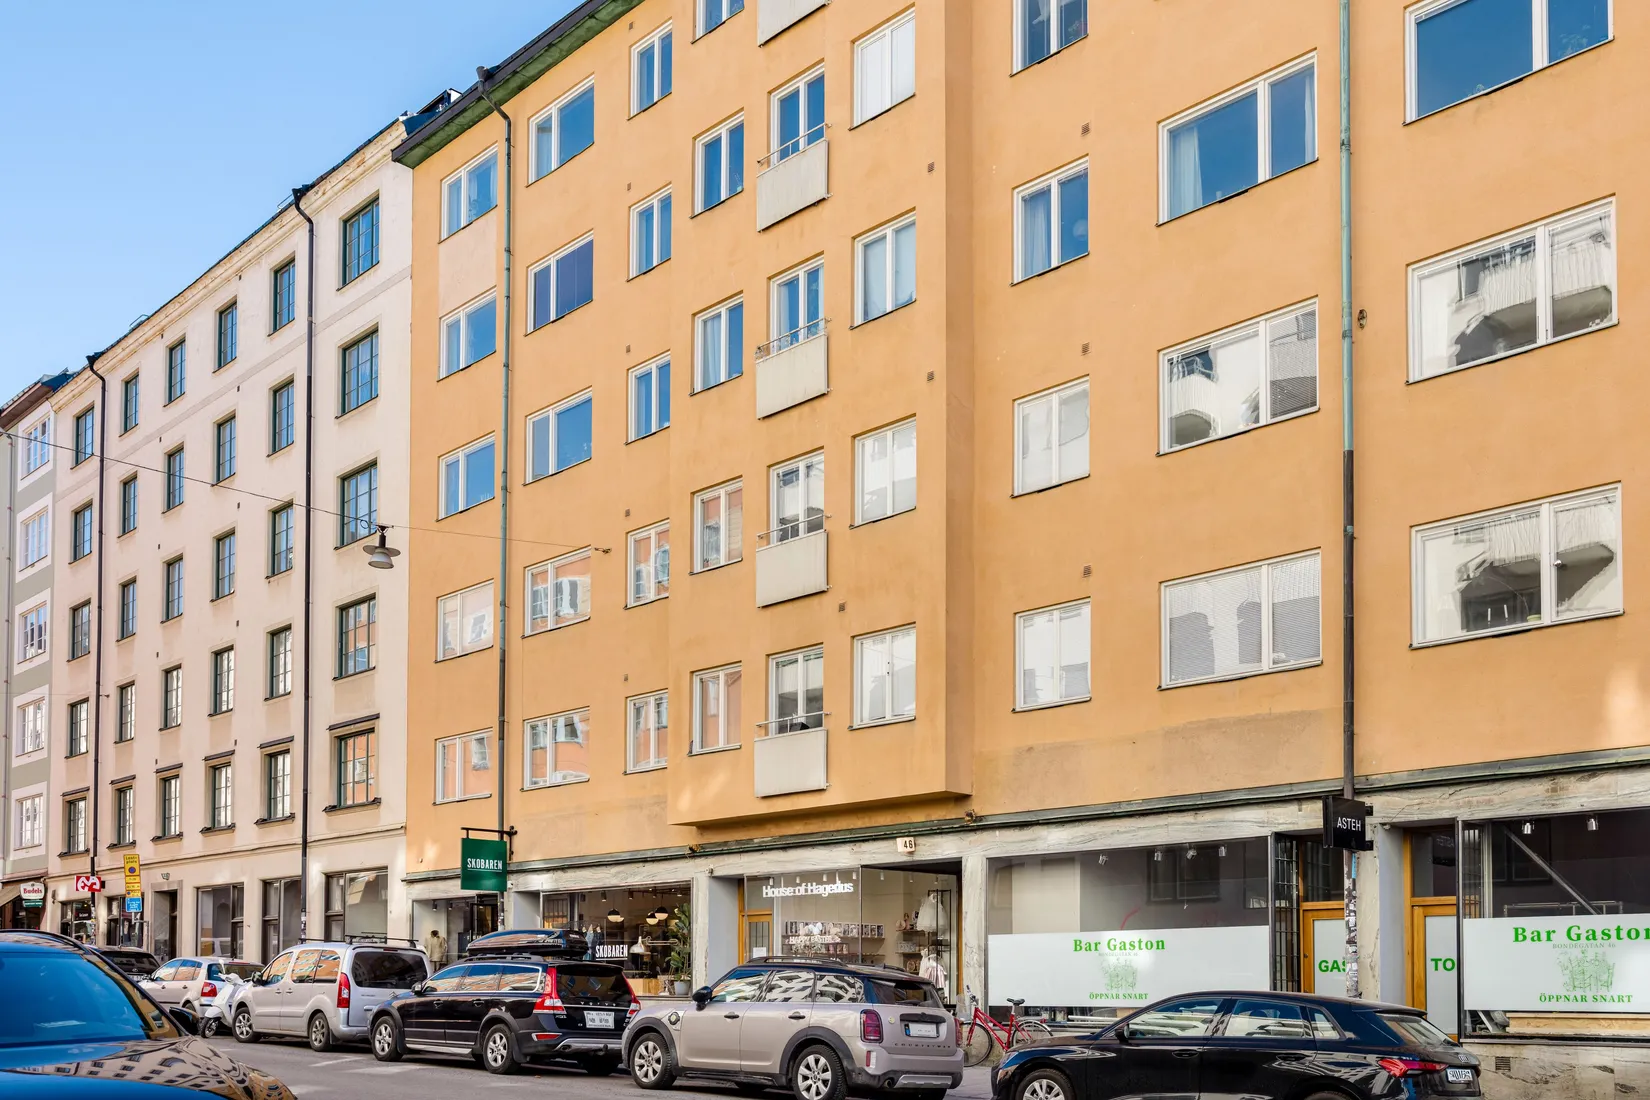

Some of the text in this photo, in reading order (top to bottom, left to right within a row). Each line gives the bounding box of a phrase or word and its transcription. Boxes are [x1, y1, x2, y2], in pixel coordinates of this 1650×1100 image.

[1337, 817, 1362, 831] ASTEH
[904, 840, 914, 849] 46
[467, 858, 502, 870] SKOBAREN
[763, 885, 794, 898] House
[795, 883, 807, 895] of
[1513, 926, 1557, 943] Bar
[595, 944, 628, 958] SKOBAREN
[1073, 938, 1165, 952] Bar Gaston
[1089, 991, 1120, 1000] ÖPPNAR
[1539, 992, 1633, 1003] ÖPPNAR SNART
